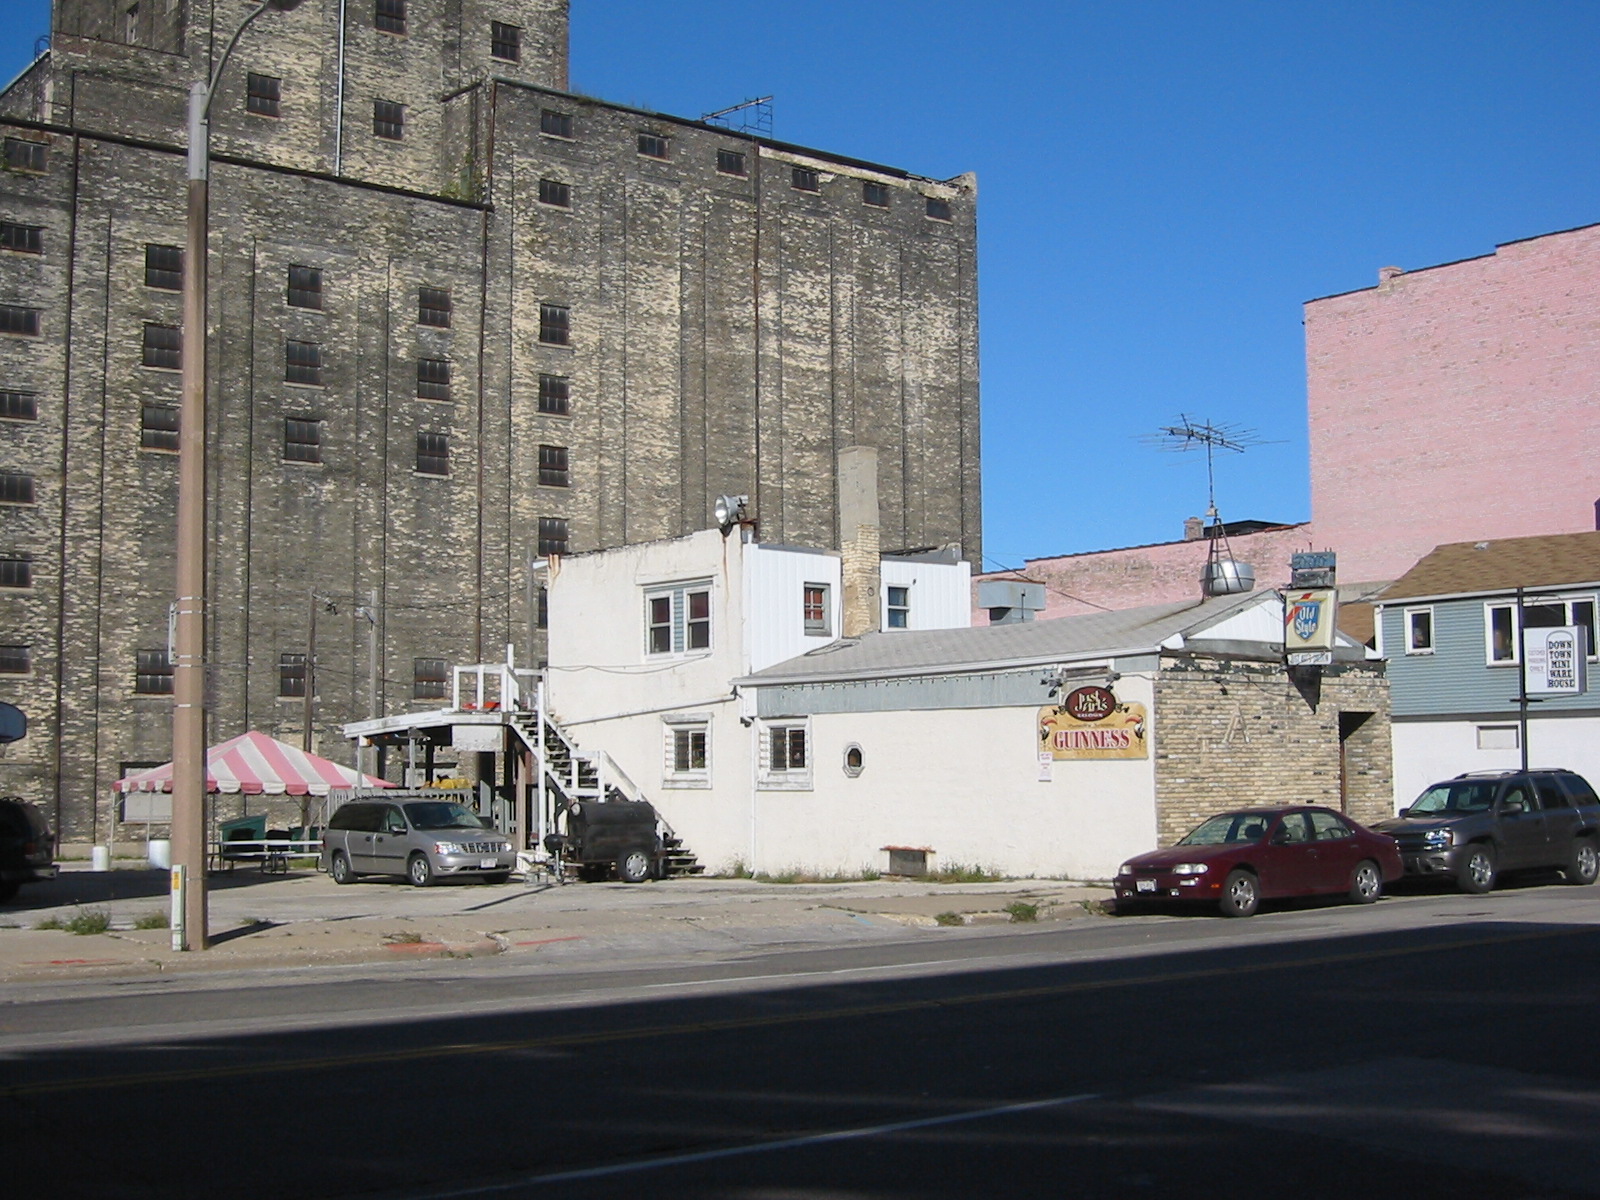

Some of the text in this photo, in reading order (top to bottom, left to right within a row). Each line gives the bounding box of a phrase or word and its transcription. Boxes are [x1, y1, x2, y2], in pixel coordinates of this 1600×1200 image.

[1300, 606, 1315, 620] Old
[1296, 619, 1317, 638] Style
[1548, 641, 1572, 650] DOWN
[1549, 650, 1571, 659] TOWN
[1551, 660, 1570, 669] MINI
[1550, 669, 1572, 678] WARE
[1547, 679, 1575, 688] HOUSE
[1053, 729, 1130, 749] GUINNESS
